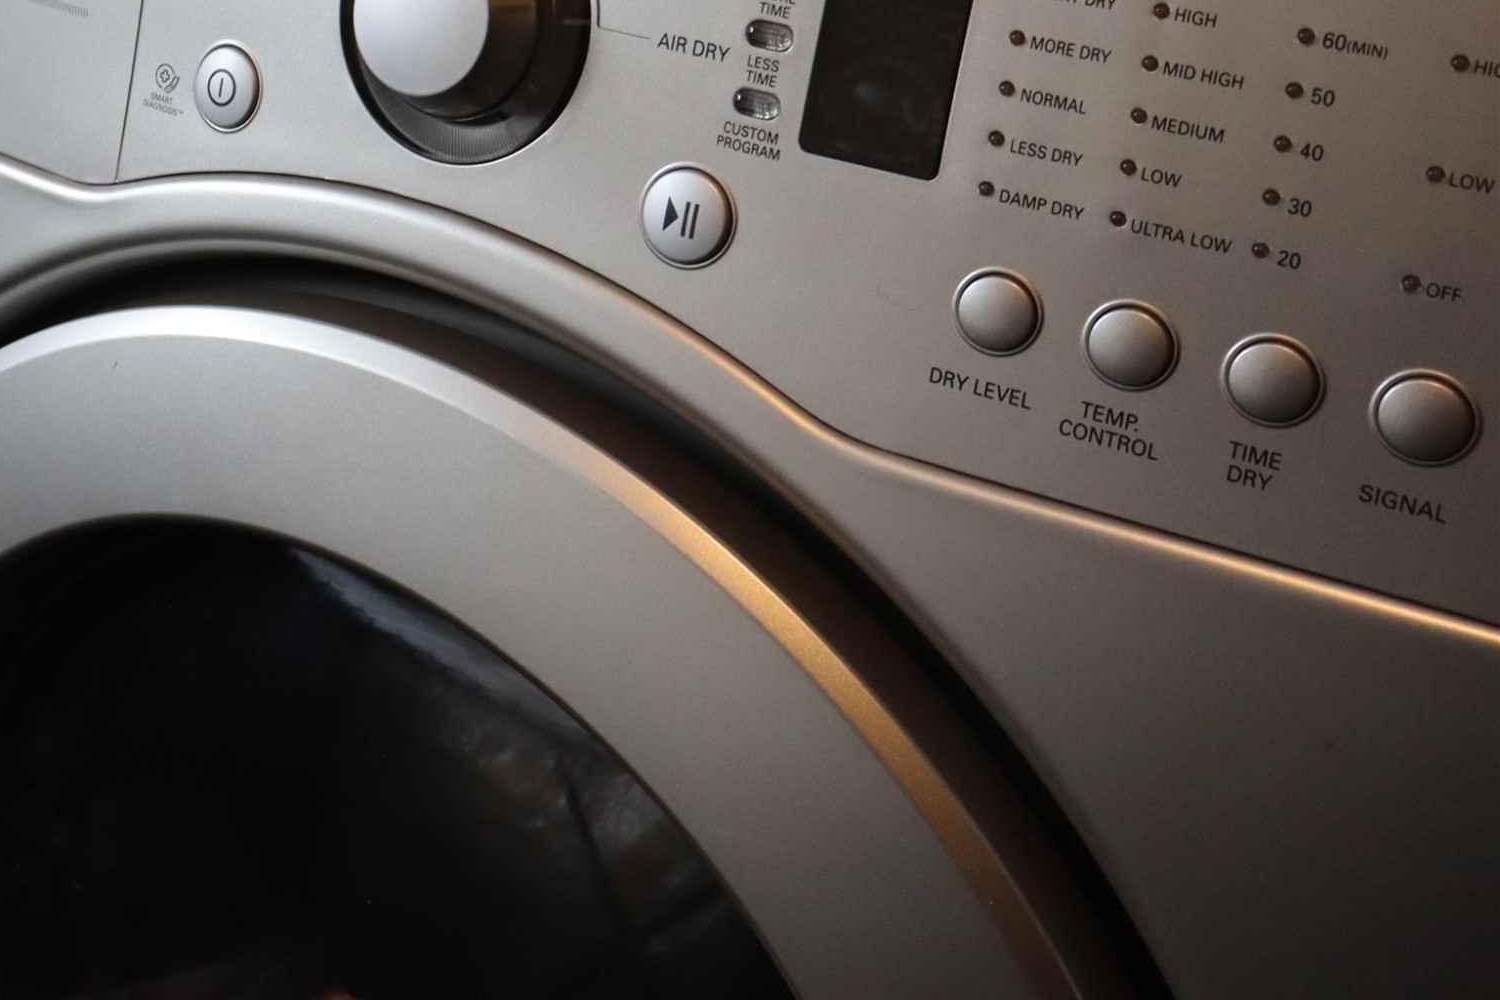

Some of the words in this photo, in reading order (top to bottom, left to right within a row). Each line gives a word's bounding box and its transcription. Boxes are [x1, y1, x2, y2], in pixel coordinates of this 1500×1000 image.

[760, 2, 791, 19] TIME
[1174, 7, 1218, 28] HIGH
[657, 32, 688, 53] AIR
[692, 40, 731, 62] DRY
[1030, 36, 1076, 57] MORE
[1079, 45, 1112, 64] DRY
[747, 55, 780, 72] LESS
[1163, 61, 1196, 80] MID
[1200, 68, 1244, 90] HIGH
[746, 70, 778, 87] TIME
[150, 92, 173, 105] SMART
[1020, 89, 1086, 115] NORMAL
[1310, 87, 1335, 107] 50
[723, 121, 779, 145] CUSTOM
[1151, 115, 1225, 143] MEDIUM
[716, 135, 781, 161] PROGRAM
[1010, 139, 1047, 159] LESS
[1051, 148, 1083, 167] DRY
[1299, 143, 1324, 162] 40
[1141, 167, 1182, 188] LOW
[1448, 172, 1495, 194] LOW
[999, 189, 1047, 211] DAMP
[1051, 201, 1085, 220] DRY
[1287, 198, 1312, 218] 30
[1131, 218, 1185, 244] ULTRA
[1190, 232, 1232, 253] LOW
[1276, 250, 1301, 270] 20
[1426, 283, 1463, 302] OFF
[929, 367, 969, 391] DRY
[973, 379, 1031, 410] LEVEL
[1081, 400, 1139, 432] TEMP.
[1059, 419, 1158, 461] CONTROL
[1229, 440, 1283, 471] TIME
[1226, 465, 1273, 491] DRY
[1358, 484, 1447, 524] SIGNAL
